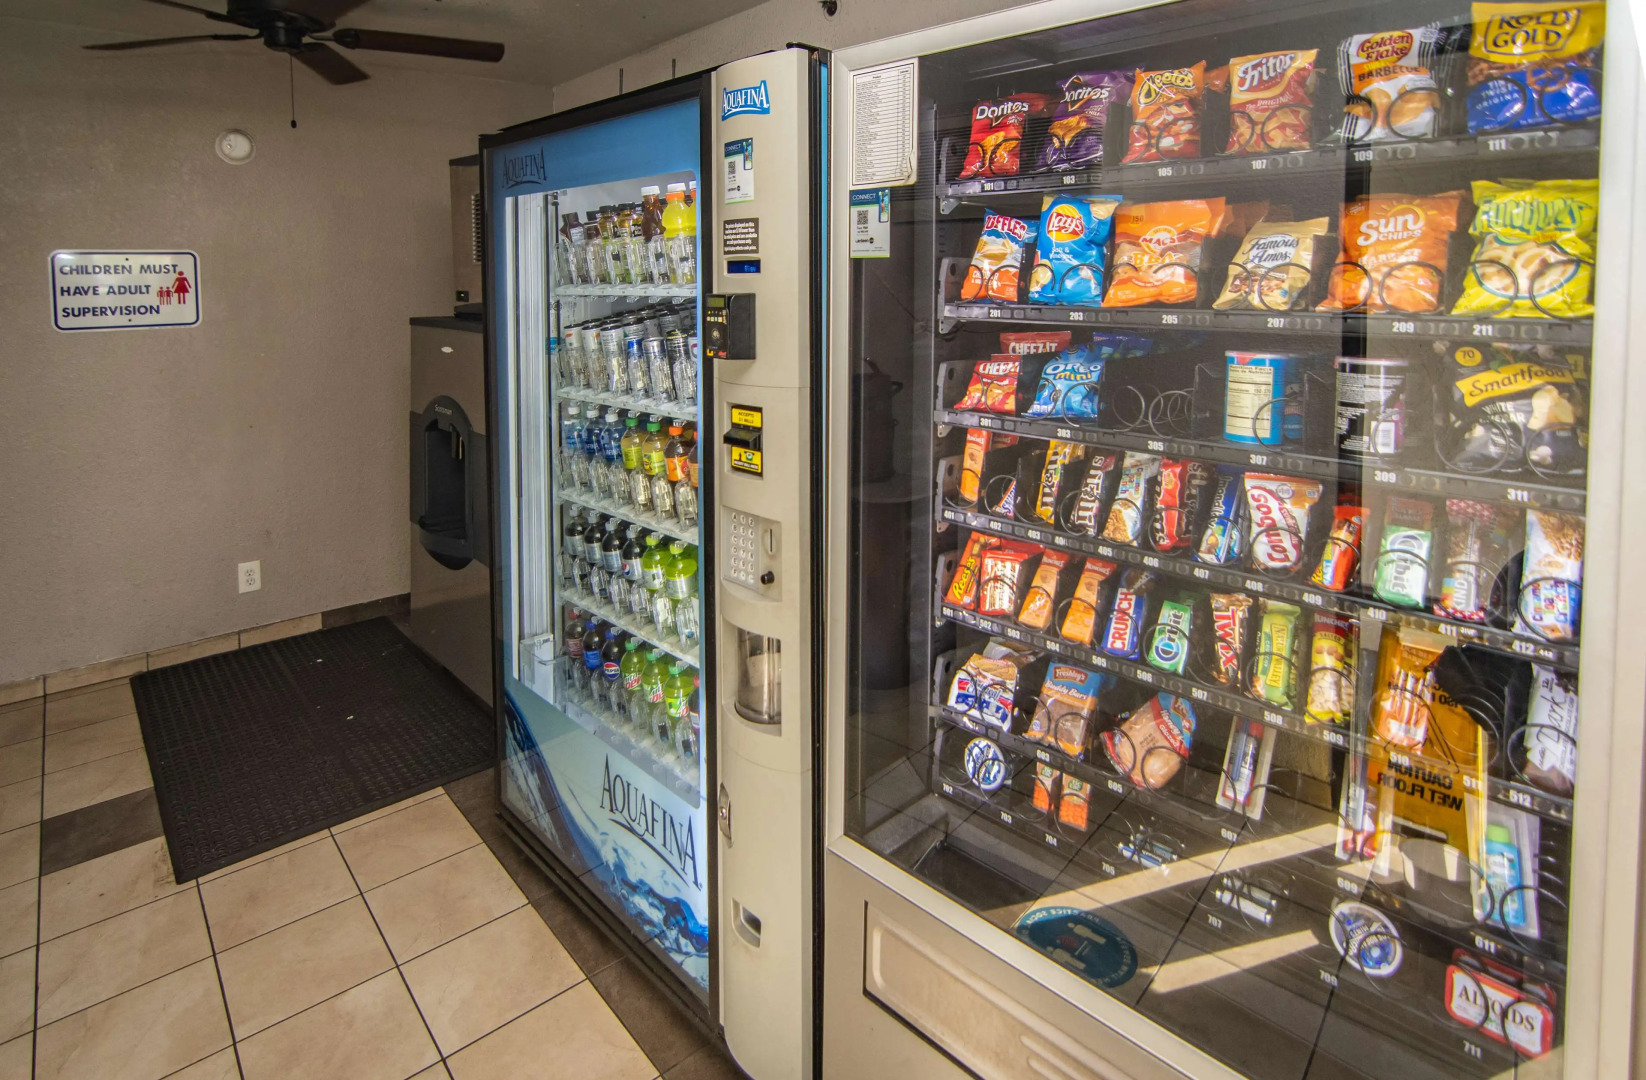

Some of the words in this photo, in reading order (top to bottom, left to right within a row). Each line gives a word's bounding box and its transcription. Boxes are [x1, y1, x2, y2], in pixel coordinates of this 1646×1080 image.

[1499, 8, 1582, 30] ROLD
[1360, 34, 1410, 53] Golden
[1492, 29, 1562, 49] GOLD
[1365, 45, 1408, 61] Flake
[1237, 53, 1296, 91] Fritos
[1358, 66, 1422, 82] BARBECUE
[722, 81, 769, 114] AQUAFINA
[1476, 93, 1521, 110] ORIGINA
[976, 101, 1030, 120] Doritos
[1487, 139, 1507, 151] 111
[1354, 151, 1373, 161] 109
[502, 146, 548, 187] AQUAFINA
[1251, 160, 1266, 169] 107
[1158, 168, 1172, 177] 105
[1063, 176, 1075, 184] 103
[983, 183, 994, 191] 101
[852, 192, 876, 201] CONNECT
[1051, 212, 1084, 234] Lay's
[1357, 213, 1425, 246] Sun
[1379, 229, 1423, 241] CHIPS
[1246, 235, 1299, 251] Famous
[1243, 250, 1290, 265] Amos
[59, 264, 132, 275] CHILDREN
[140, 264, 178, 274] MUST
[60, 286, 100, 296] HAVE
[107, 284, 151, 295] ADULT
[62, 304, 160, 317] SUPERVISION
[990, 310, 1001, 318] 201
[1069, 312, 1083, 321] 203
[1162, 315, 1178, 324] 205
[1267, 318, 1284, 328] 207
[1392, 322, 1414, 333] 209
[1473, 324, 1493, 337] 211
[1462, 350, 1475, 359] 70
[1046, 362, 1101, 375] OREO
[1054, 371, 1092, 382] mini
[1469, 364, 1566, 398] Smartfood
[980, 418, 991, 427] 301
[1057, 428, 1071, 438] 303
[1148, 441, 1164, 451] 305
[1250, 455, 1267, 466] 307
[1374, 471, 1396, 483] 309
[1507, 488, 1528, 502] 311
[989, 521, 1002, 530] 402
[1250, 493, 1291, 562] Combos
[1027, 529, 1041, 539] 403
[1098, 546, 1112, 556] 405
[1143, 556, 1159, 567] 406
[952, 556, 977, 600] Reese's
[1194, 568, 1209, 579] 407
[1245, 580, 1263, 592] 408
[1303, 592, 1322, 605] 409
[1453, 580, 1468, 609] KIND
[1530, 582, 1544, 622] Cinnamo
[943, 607, 953, 617] 501
[1367, 607, 1387, 620] 410
[980, 620, 992, 630] 502
[1109, 591, 1135, 650] CRUNCH
[1007, 627, 1021, 638] 503
[1438, 623, 1457, 637] 411
[1213, 606, 1238, 669] TWIX
[1046, 640, 1059, 652] 504
[1512, 640, 1535, 656] 412
[1092, 655, 1107, 667] 505
[1136, 670, 1153, 682] 506
[1192, 687, 1208, 700] 507
[1264, 711, 1283, 725] 508
[1535, 696, 1566, 744] Dark
[1323, 730, 1344, 744] 509
[1036, 749, 1050, 762] 603
[1390, 752, 1409, 766] 510
[943, 783, 953, 794] 702
[1107, 780, 1123, 793] 605
[1509, 790, 1532, 806] 512
[600, 753, 702, 891] AQUAFINA
[1001, 811, 1012, 824] 703
[1221, 828, 1238, 842] 607
[1337, 877, 1358, 893] 609
[1207, 914, 1222, 929] 707
[1475, 936, 1497, 954] 611
[1319, 969, 1338, 987] 709
[1463, 1041, 1482, 1059] 711
